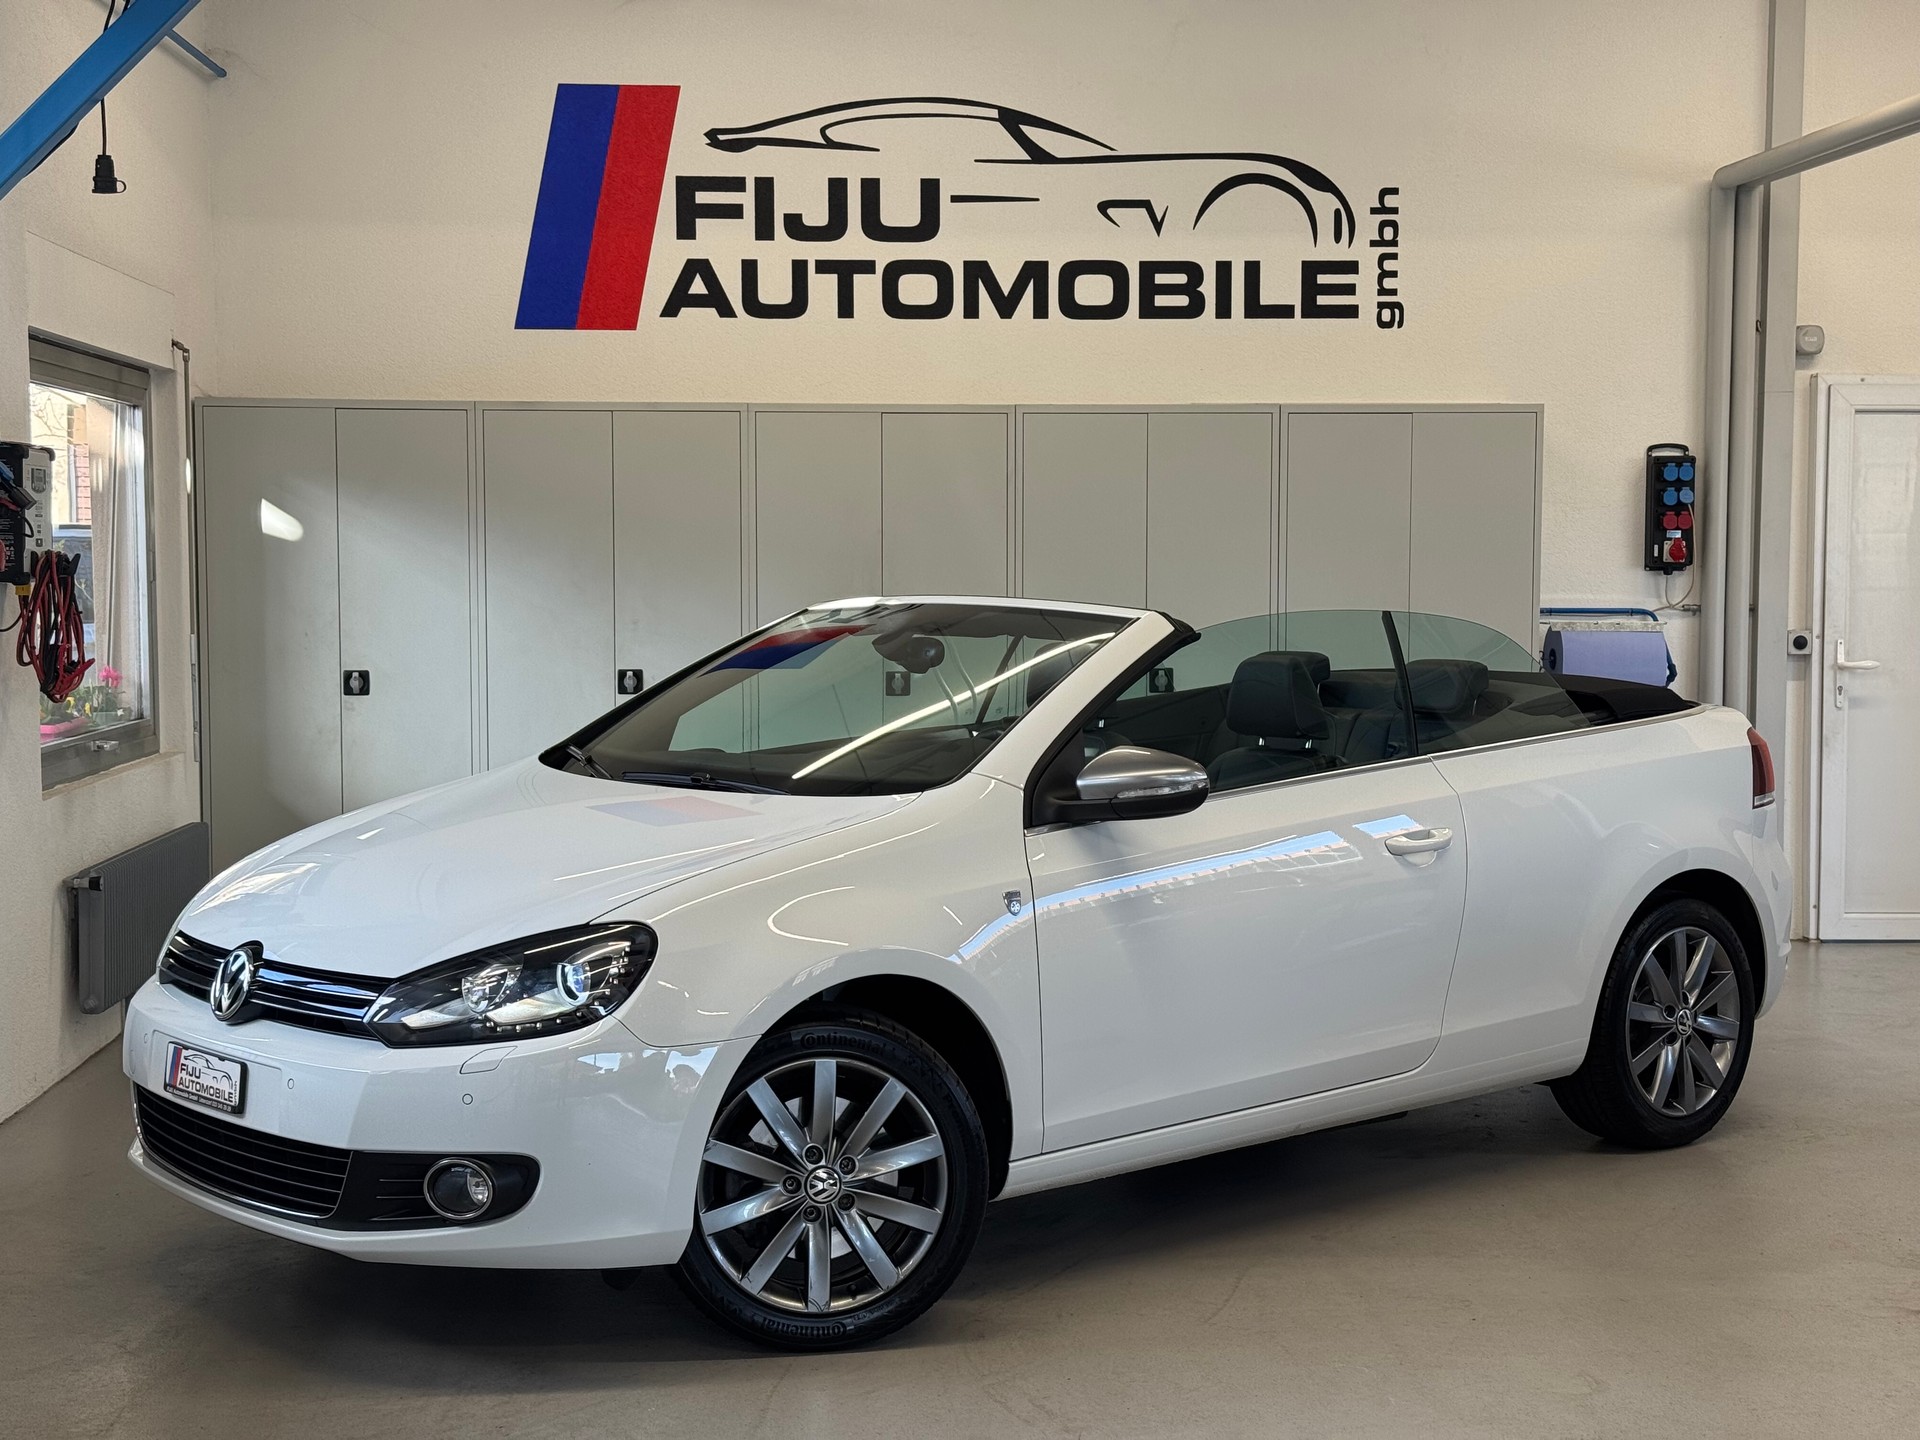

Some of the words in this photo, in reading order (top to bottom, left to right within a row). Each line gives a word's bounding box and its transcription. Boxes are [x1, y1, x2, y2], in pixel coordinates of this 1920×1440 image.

[675, 176, 941, 243] FIJU
[659, 258, 1360, 320] AUTOMOBILE
[1369, 187, 1405, 329] gmbh
[178, 1076, 234, 1103] AUTOMOBILE
[180, 1062, 202, 1079] FIJU
